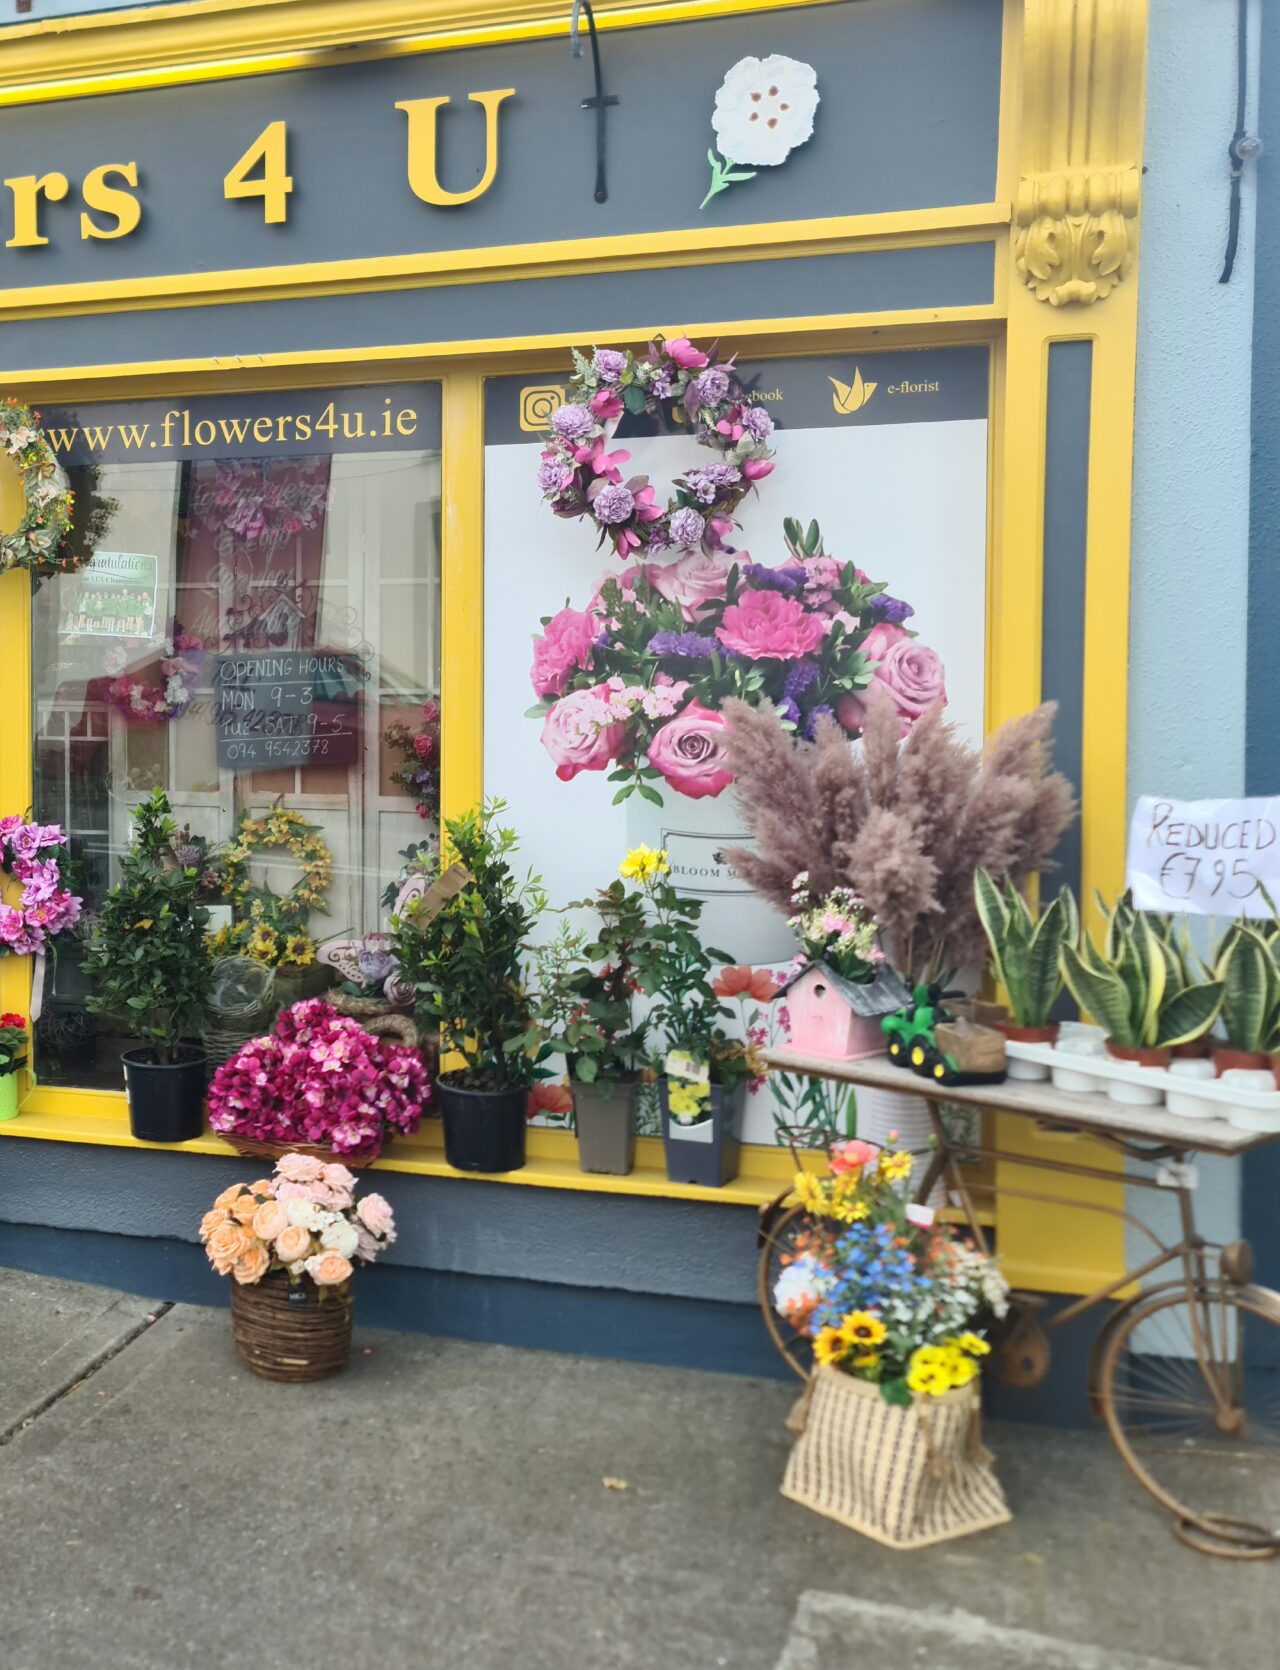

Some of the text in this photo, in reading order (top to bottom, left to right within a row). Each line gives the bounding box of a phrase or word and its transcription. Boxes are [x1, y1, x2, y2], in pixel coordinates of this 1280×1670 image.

[224, 121, 293, 224] 4
[394, 88, 516, 206] U
[887, 379, 940, 394] e-florist
[46, 399, 418, 452] www.flowers4u.ie
[220, 656, 346, 683] OPENING HOURS
[222, 691, 254, 711] MON
[227, 739, 329, 760] 094 9542378
[1146, 802, 1277, 850] REDUCED
[673, 864, 720, 878] BLOOM
